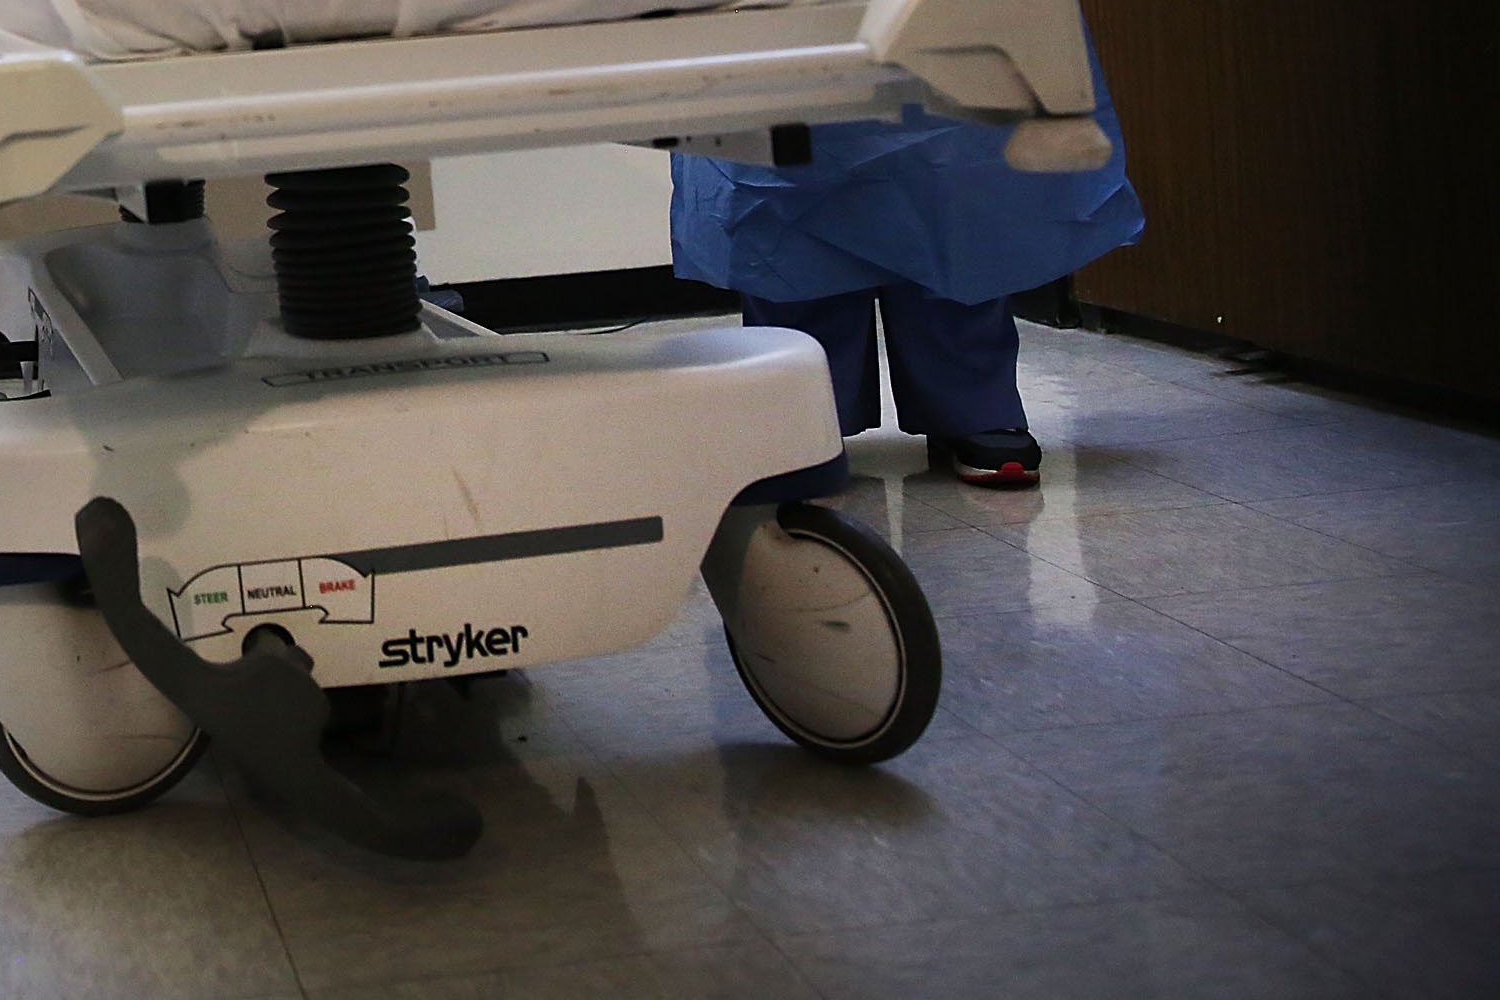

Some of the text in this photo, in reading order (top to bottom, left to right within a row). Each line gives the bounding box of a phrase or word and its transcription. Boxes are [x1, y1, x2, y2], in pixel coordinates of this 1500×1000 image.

[303, 354, 508, 380] TRANSPORT
[194, 579, 357, 605] STEER NEUTRAL BRAKE
[378, 622, 529, 669] stryker
